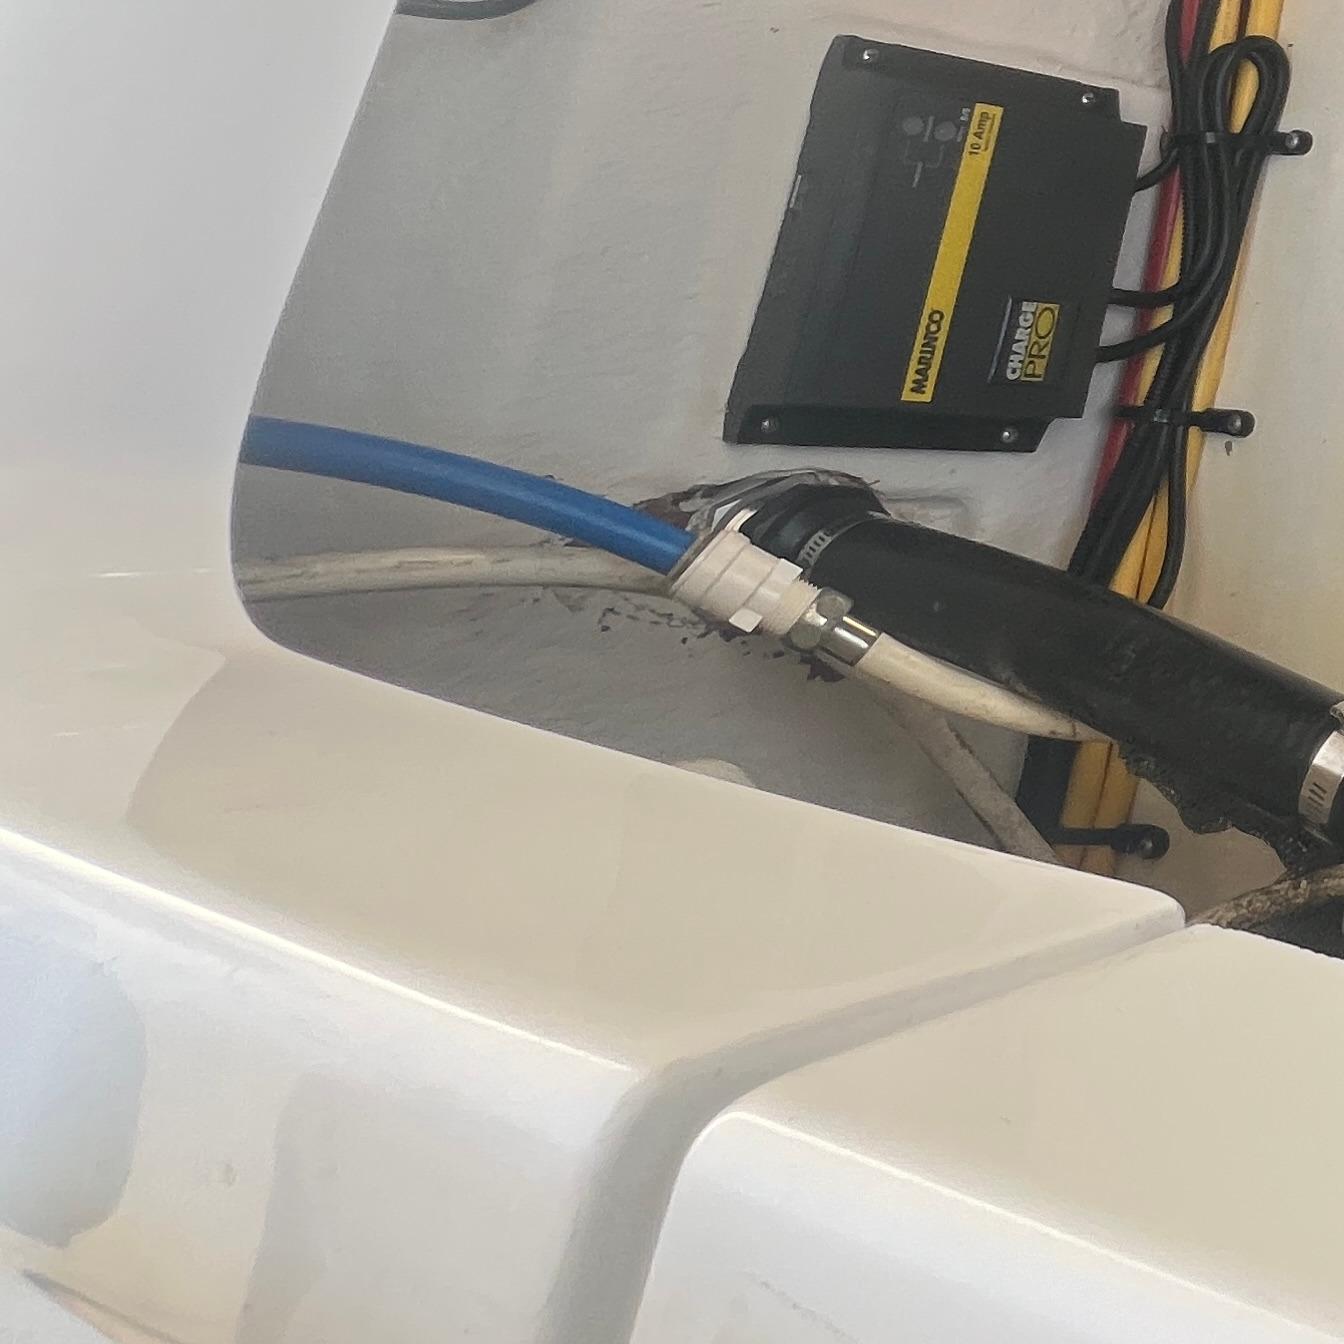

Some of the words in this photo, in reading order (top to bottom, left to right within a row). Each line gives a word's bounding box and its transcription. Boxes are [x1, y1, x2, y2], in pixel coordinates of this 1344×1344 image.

[968, 142, 981, 157] 10
[973, 111, 991, 140] Amp
[910, 309, 945, 395] MARINCO
[1006, 301, 1037, 380] CHARGE
[1024, 306, 1055, 379] PRO
